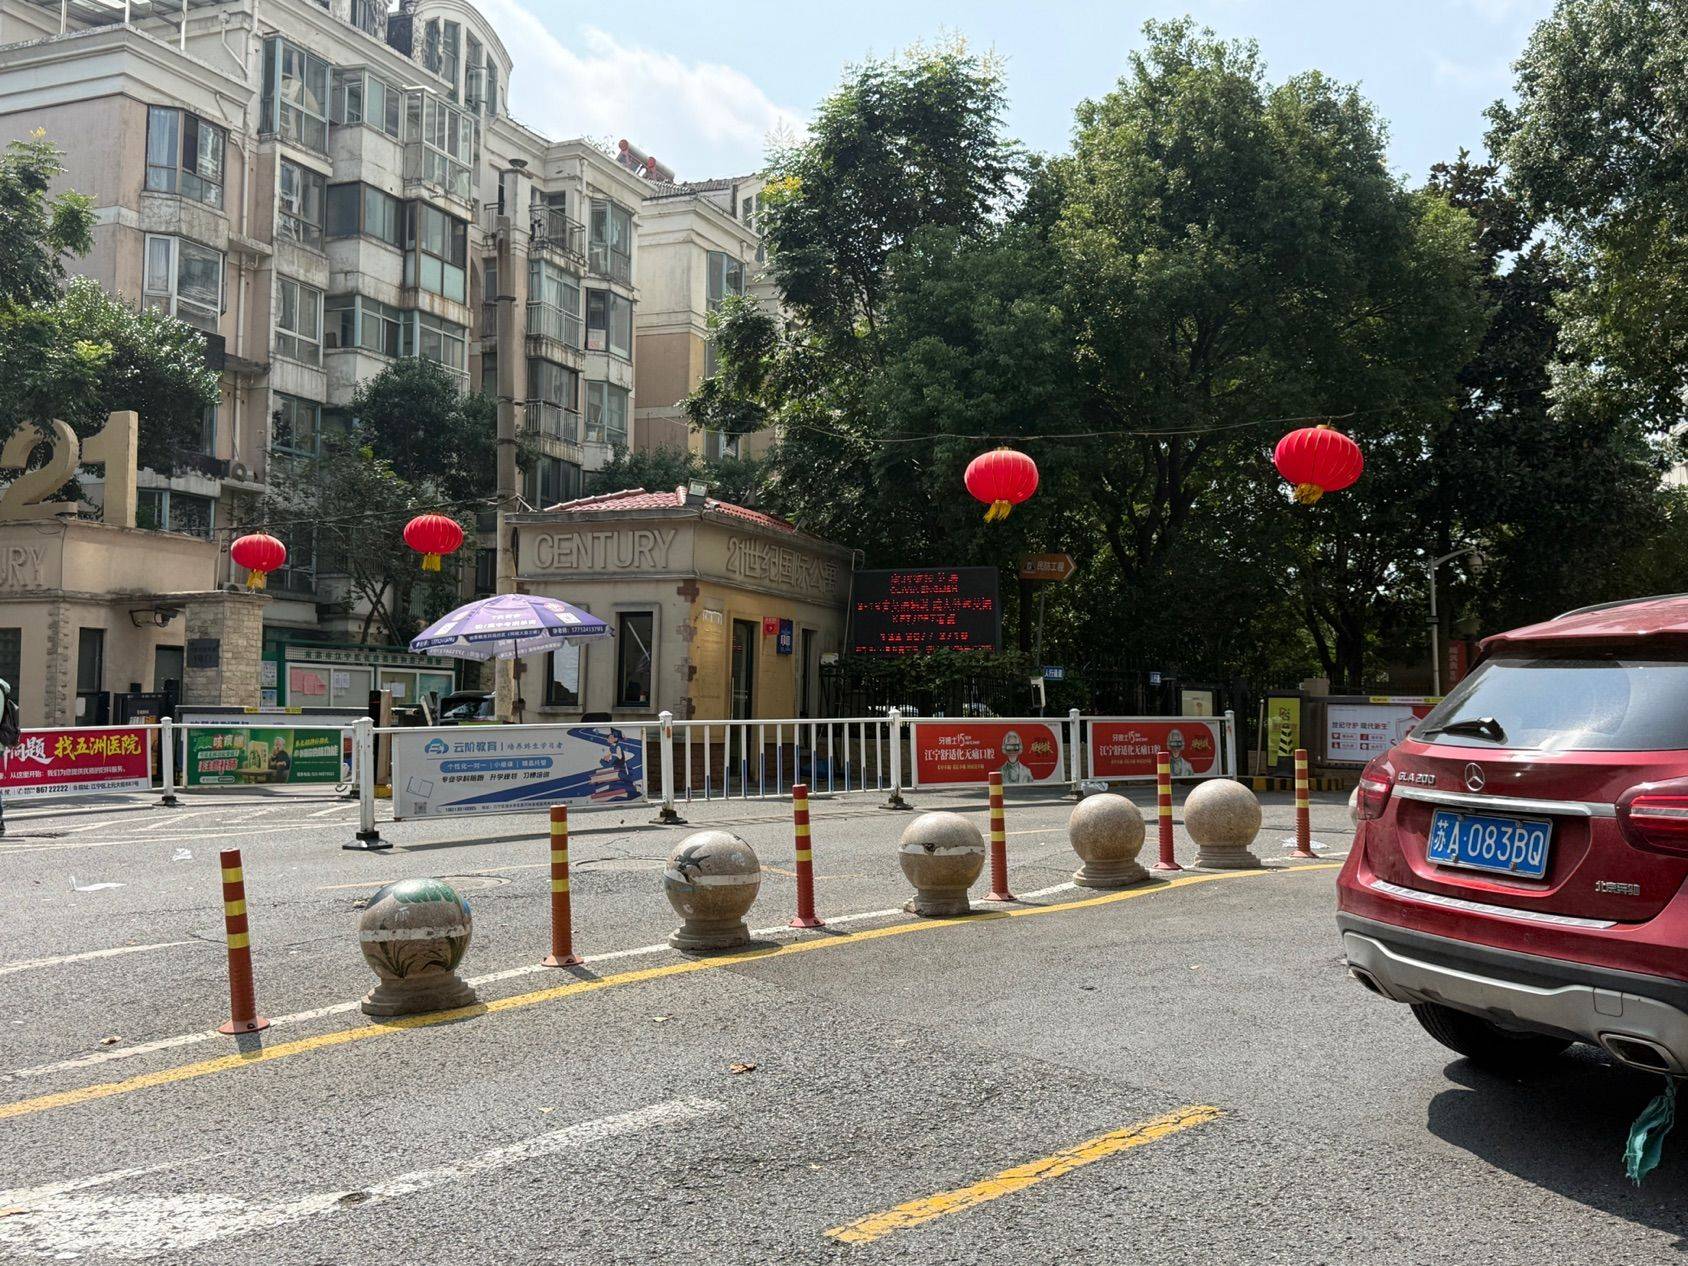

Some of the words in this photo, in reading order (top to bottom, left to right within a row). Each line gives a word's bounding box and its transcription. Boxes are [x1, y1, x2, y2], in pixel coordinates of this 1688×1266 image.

[0, 410, 138, 528] 21
[534, 528, 679, 570] CENTURY
[725, 535, 841, 595] 21世纪国际公寓
[54, 734, 141, 764] 找五洲医院
[454, 741, 497, 753] 云阶教育
[49, 785, 69, 793] 22222
[1398, 771, 1415, 782] GLA
[1416, 773, 1436, 784] 200
